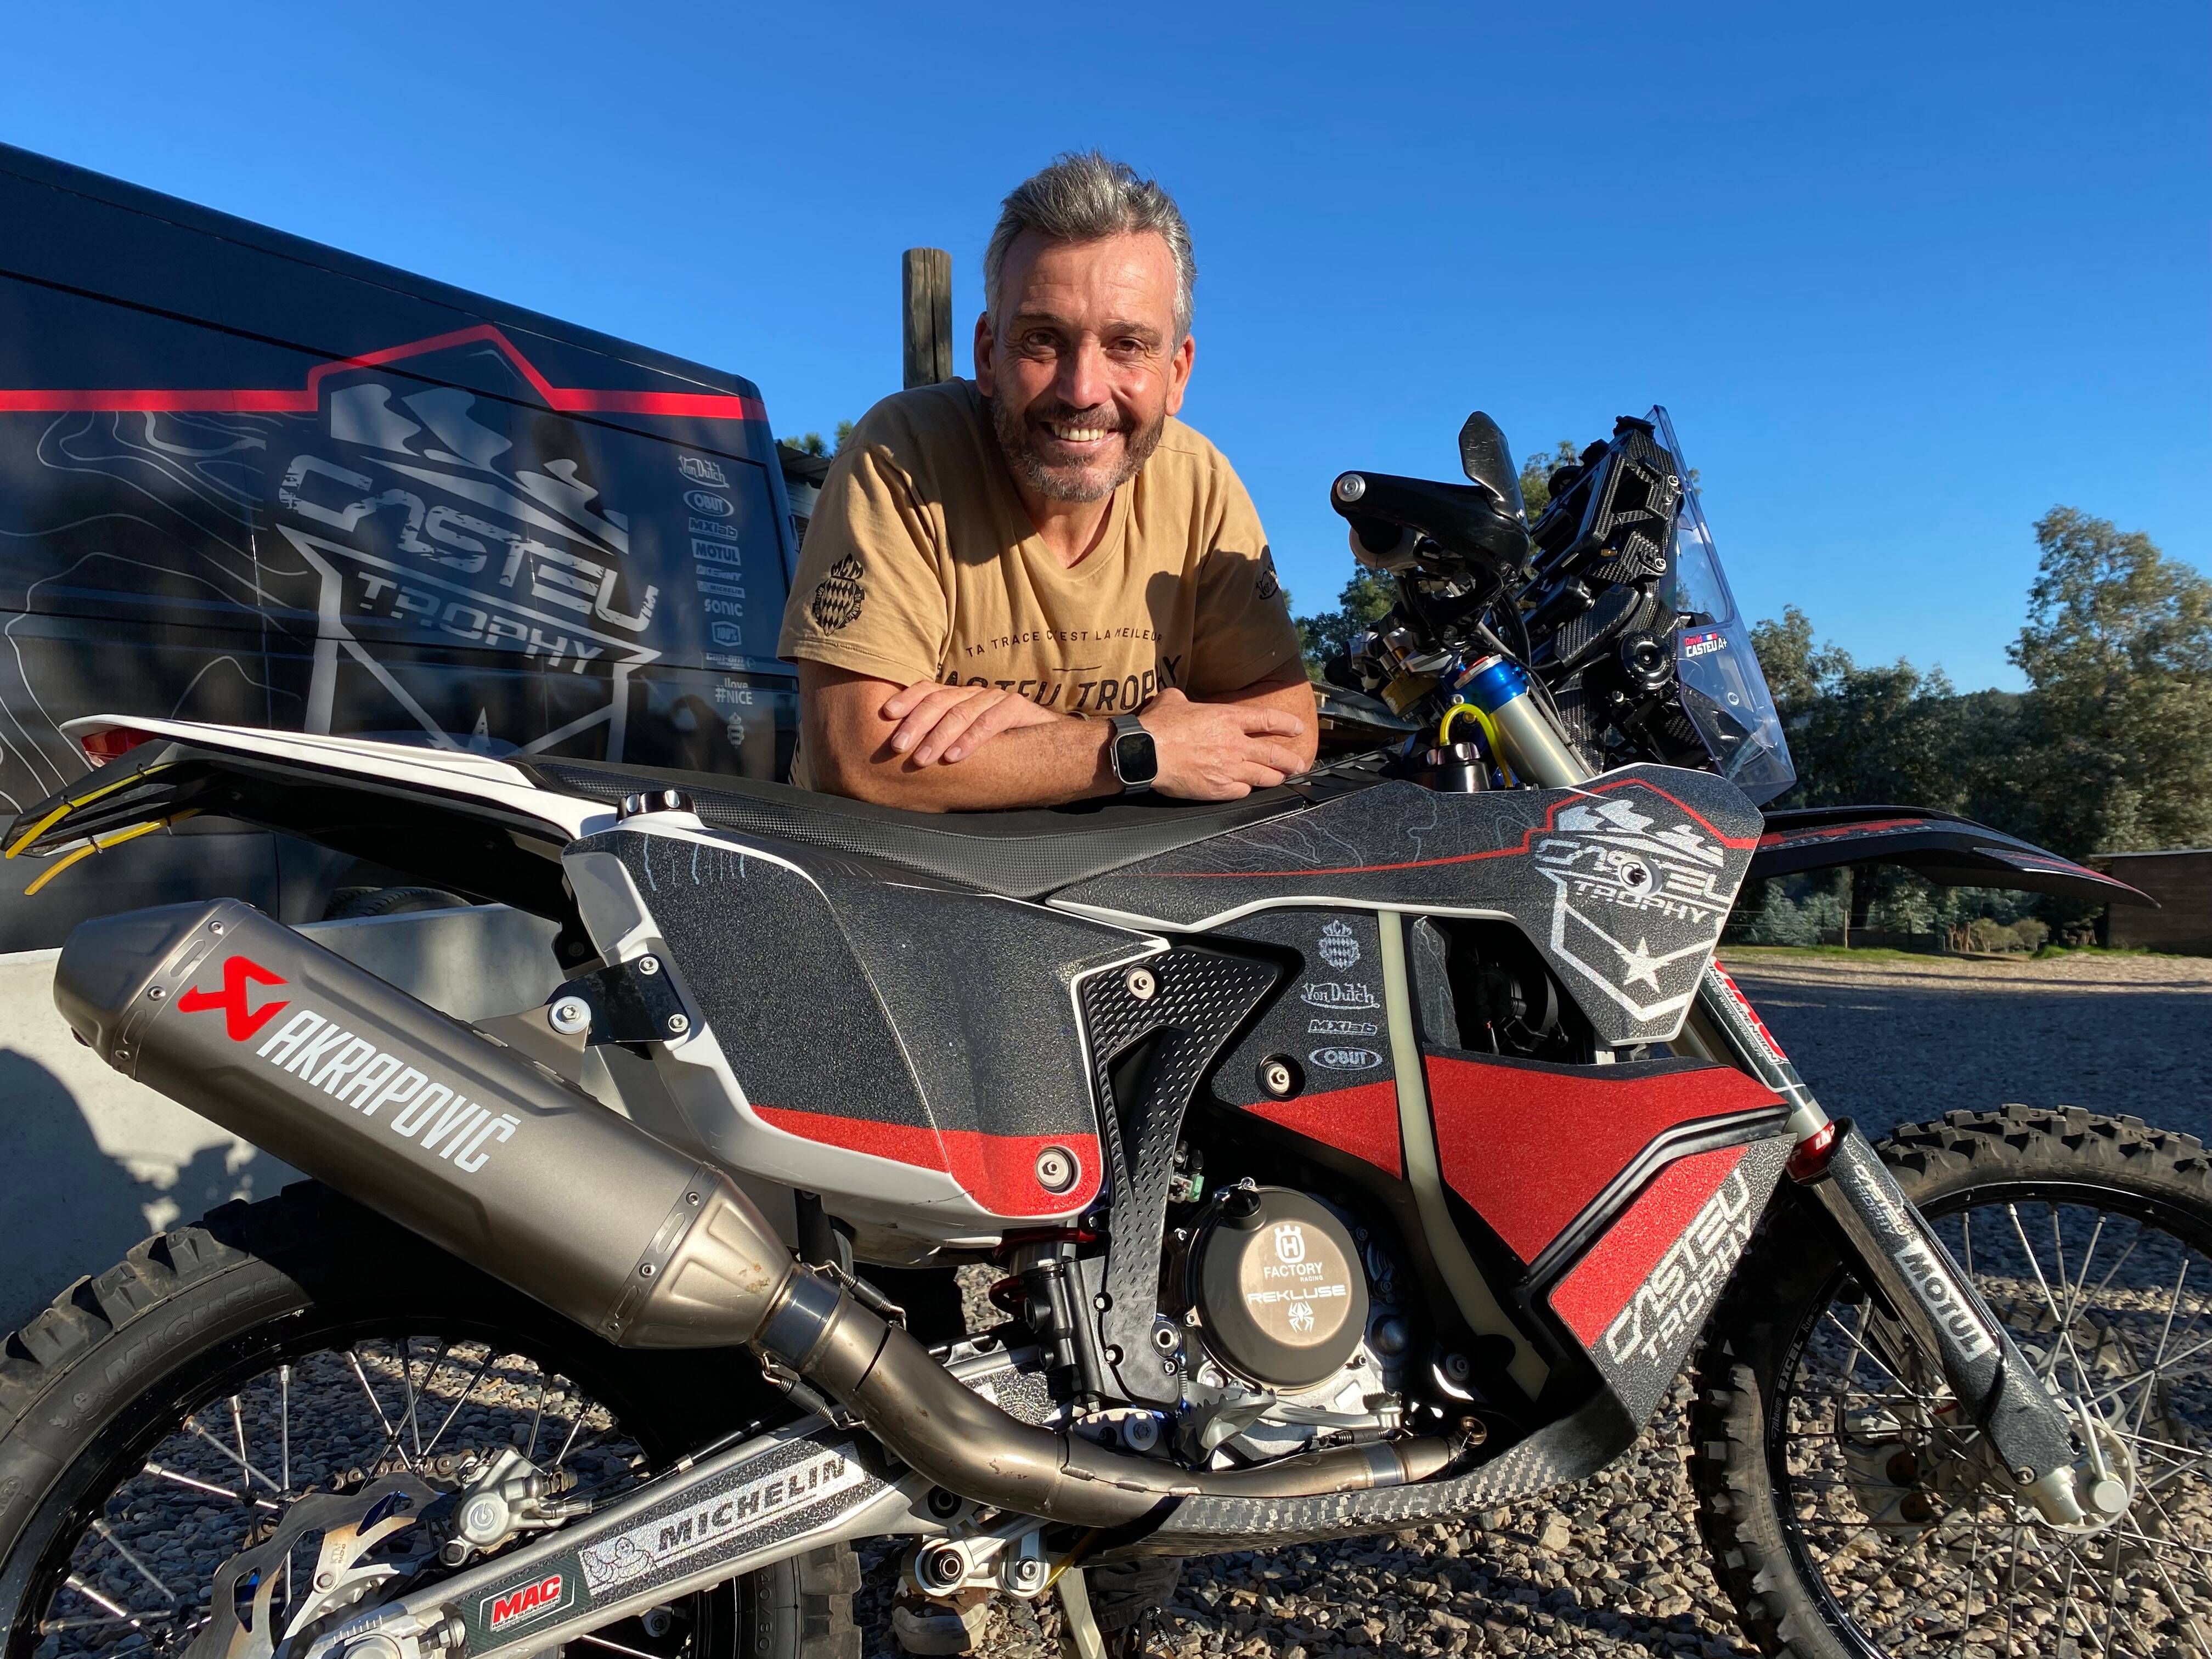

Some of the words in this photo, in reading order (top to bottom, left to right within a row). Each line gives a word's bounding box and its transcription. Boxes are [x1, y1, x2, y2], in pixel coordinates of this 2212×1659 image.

[693, 494, 723, 512] OBUT
[696, 543, 738, 562] MOTUL
[358, 571, 604, 675] TROPHY
[716, 627, 737, 641] 100%
[966, 645, 985, 658] TA
[991, 631, 1040, 650] TRACE
[1046, 631, 1088, 642] C'EST
[1096, 631, 1110, 641] LA
[1685, 634, 1703, 646] David
[1686, 639, 1718, 658] CASTEU
[1718, 637, 1728, 650] A+
[715, 685, 753, 705] #NICE
[1574, 879, 1709, 923] TROPHY
[1302, 982, 1330, 1003] Von
[1331, 982, 1375, 1005] Dutch
[1723, 988, 1778, 1060] SUSPENSION
[1324, 1049, 1367, 1065] OBUT
[1263, 1262, 1323, 1279] FACTORY
[1247, 1284, 1346, 1305] REKLUSE
[1641, 1210, 1751, 1368] TROPHY
[1902, 1252, 1983, 1353] MOTUL
[1778, 1340, 1803, 1392] EXCEL
[659, 1454, 845, 1551] MICHELIN
[493, 1575, 561, 1624] MAC
[493, 1615, 516, 1629] RACING
[517, 1597, 559, 1617] SUSPENSION
